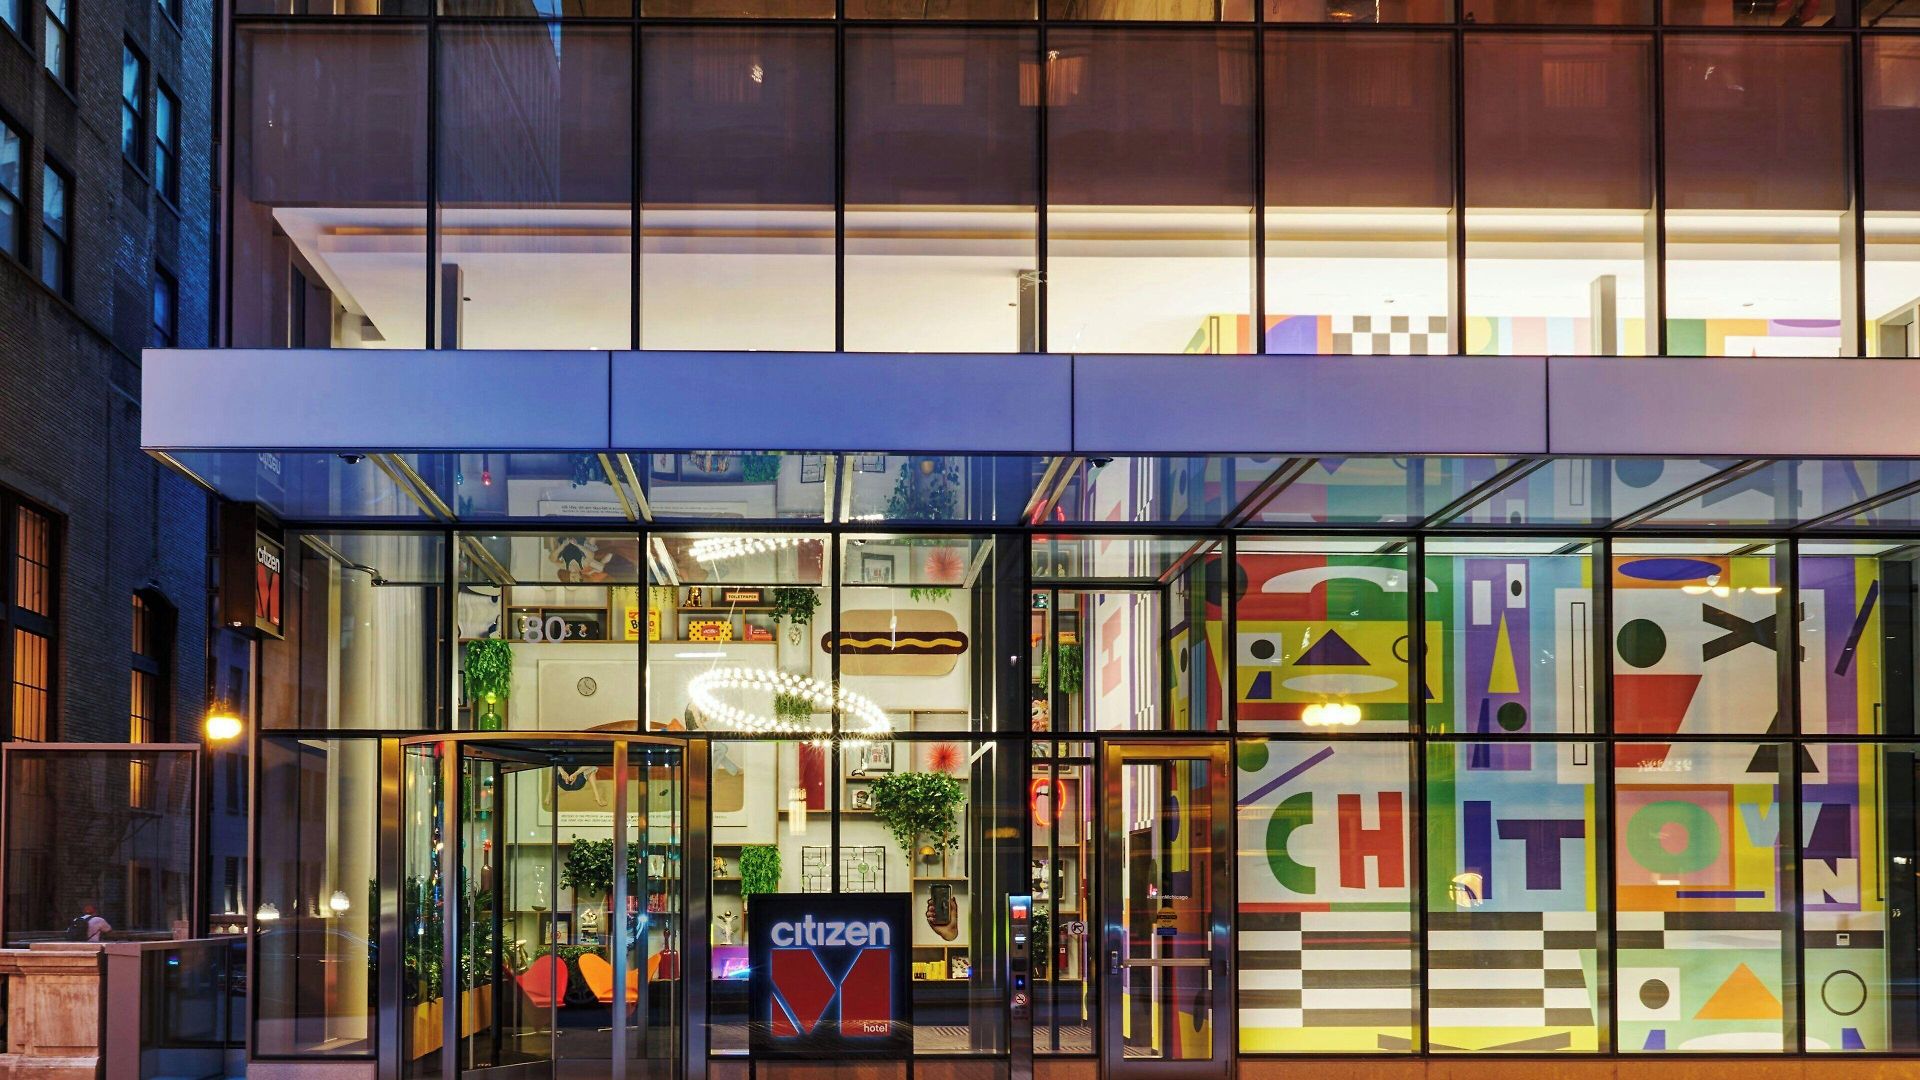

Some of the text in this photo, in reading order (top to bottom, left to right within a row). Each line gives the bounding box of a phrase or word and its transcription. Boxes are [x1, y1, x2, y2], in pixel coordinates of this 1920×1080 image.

[257, 546, 281, 574] citizen
[524, 616, 566, 644] 80
[771, 914, 891, 946] citizen
[771, 948, 891, 1037] M
[863, 1023, 888, 1033] hotel
